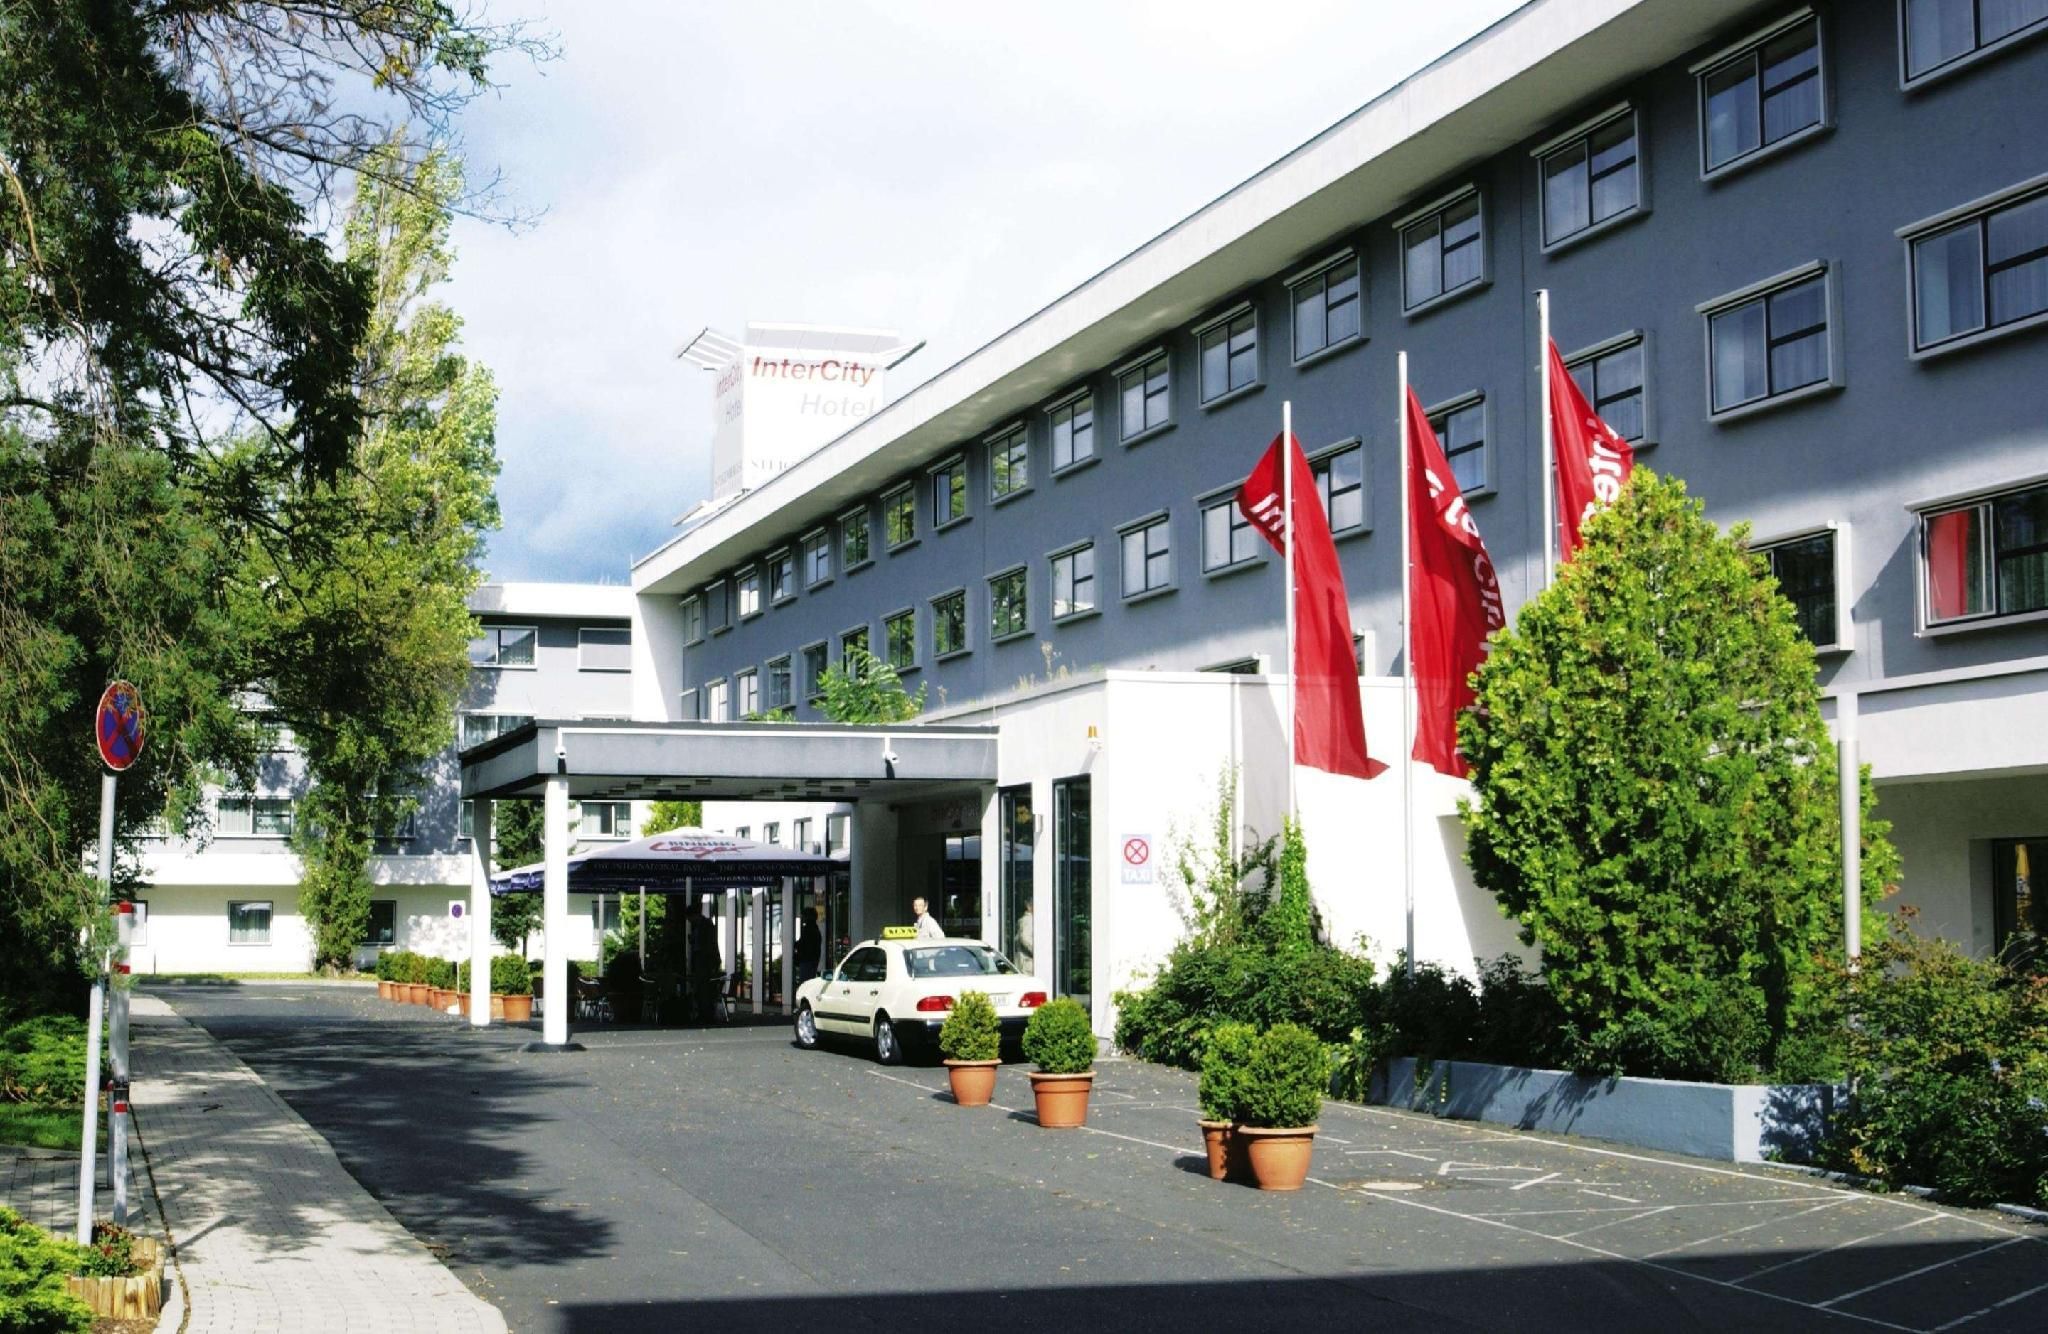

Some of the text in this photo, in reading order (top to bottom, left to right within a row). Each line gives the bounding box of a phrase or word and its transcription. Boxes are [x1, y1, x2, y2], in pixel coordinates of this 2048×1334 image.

[752, 355, 876, 388] InterCity
[800, 393, 877, 417] Hotel
[1122, 868, 1151, 881] TAXI
